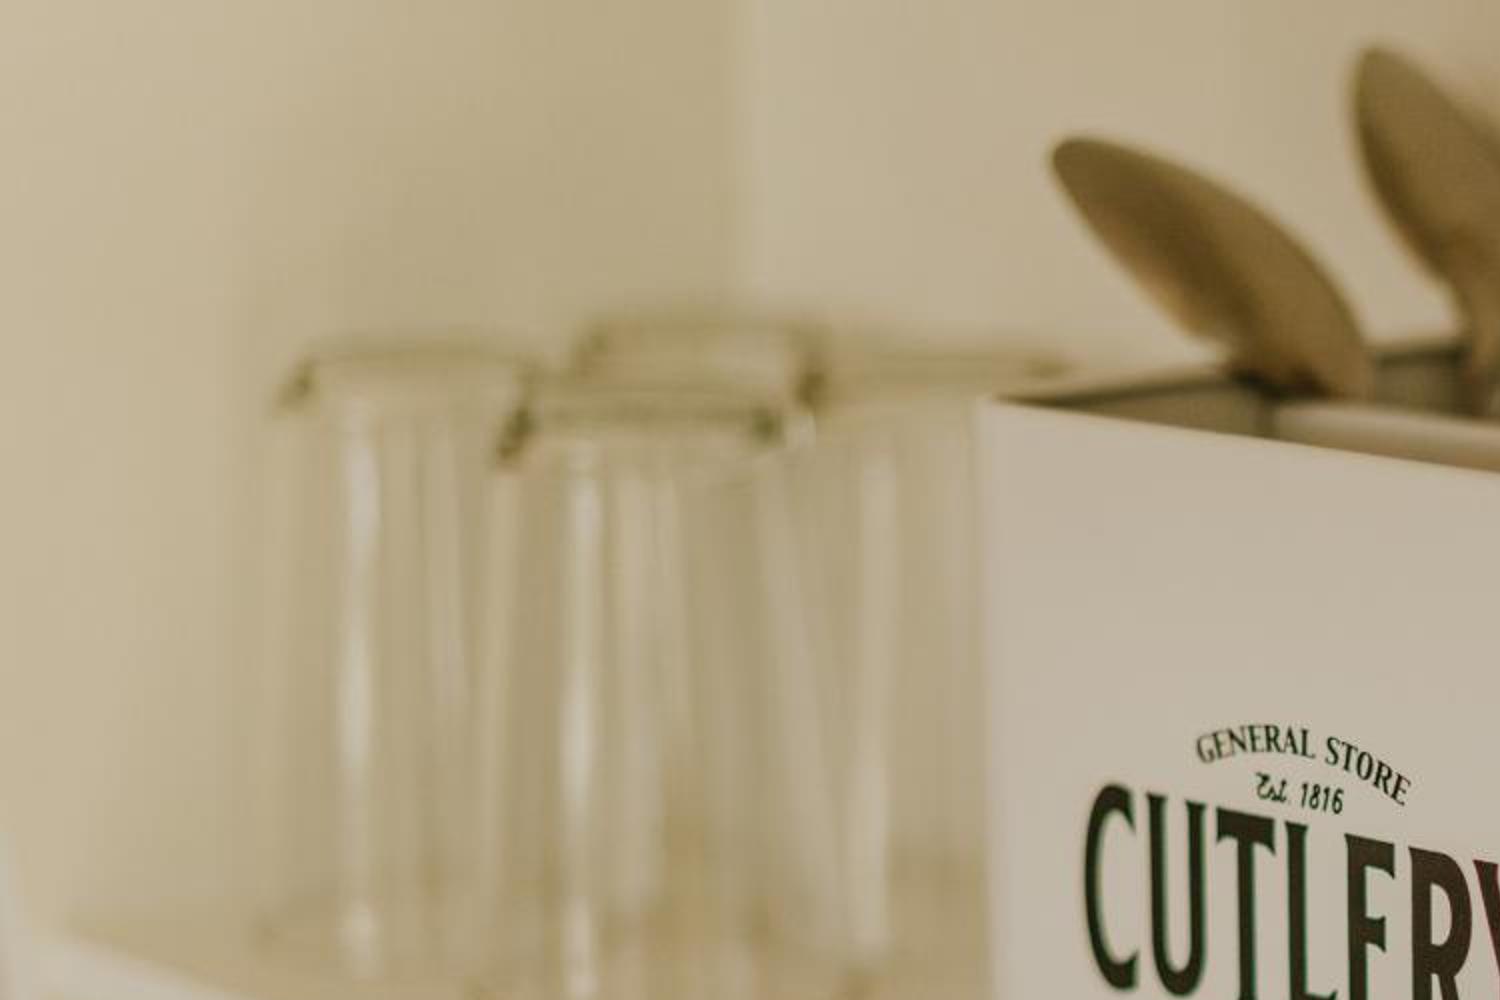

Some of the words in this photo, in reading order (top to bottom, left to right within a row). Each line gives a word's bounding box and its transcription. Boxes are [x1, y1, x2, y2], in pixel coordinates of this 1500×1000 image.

[1196, 724, 1316, 764] GENERAL
[1324, 736, 1412, 807] STORE
[1301, 782, 1344, 815] 1816
